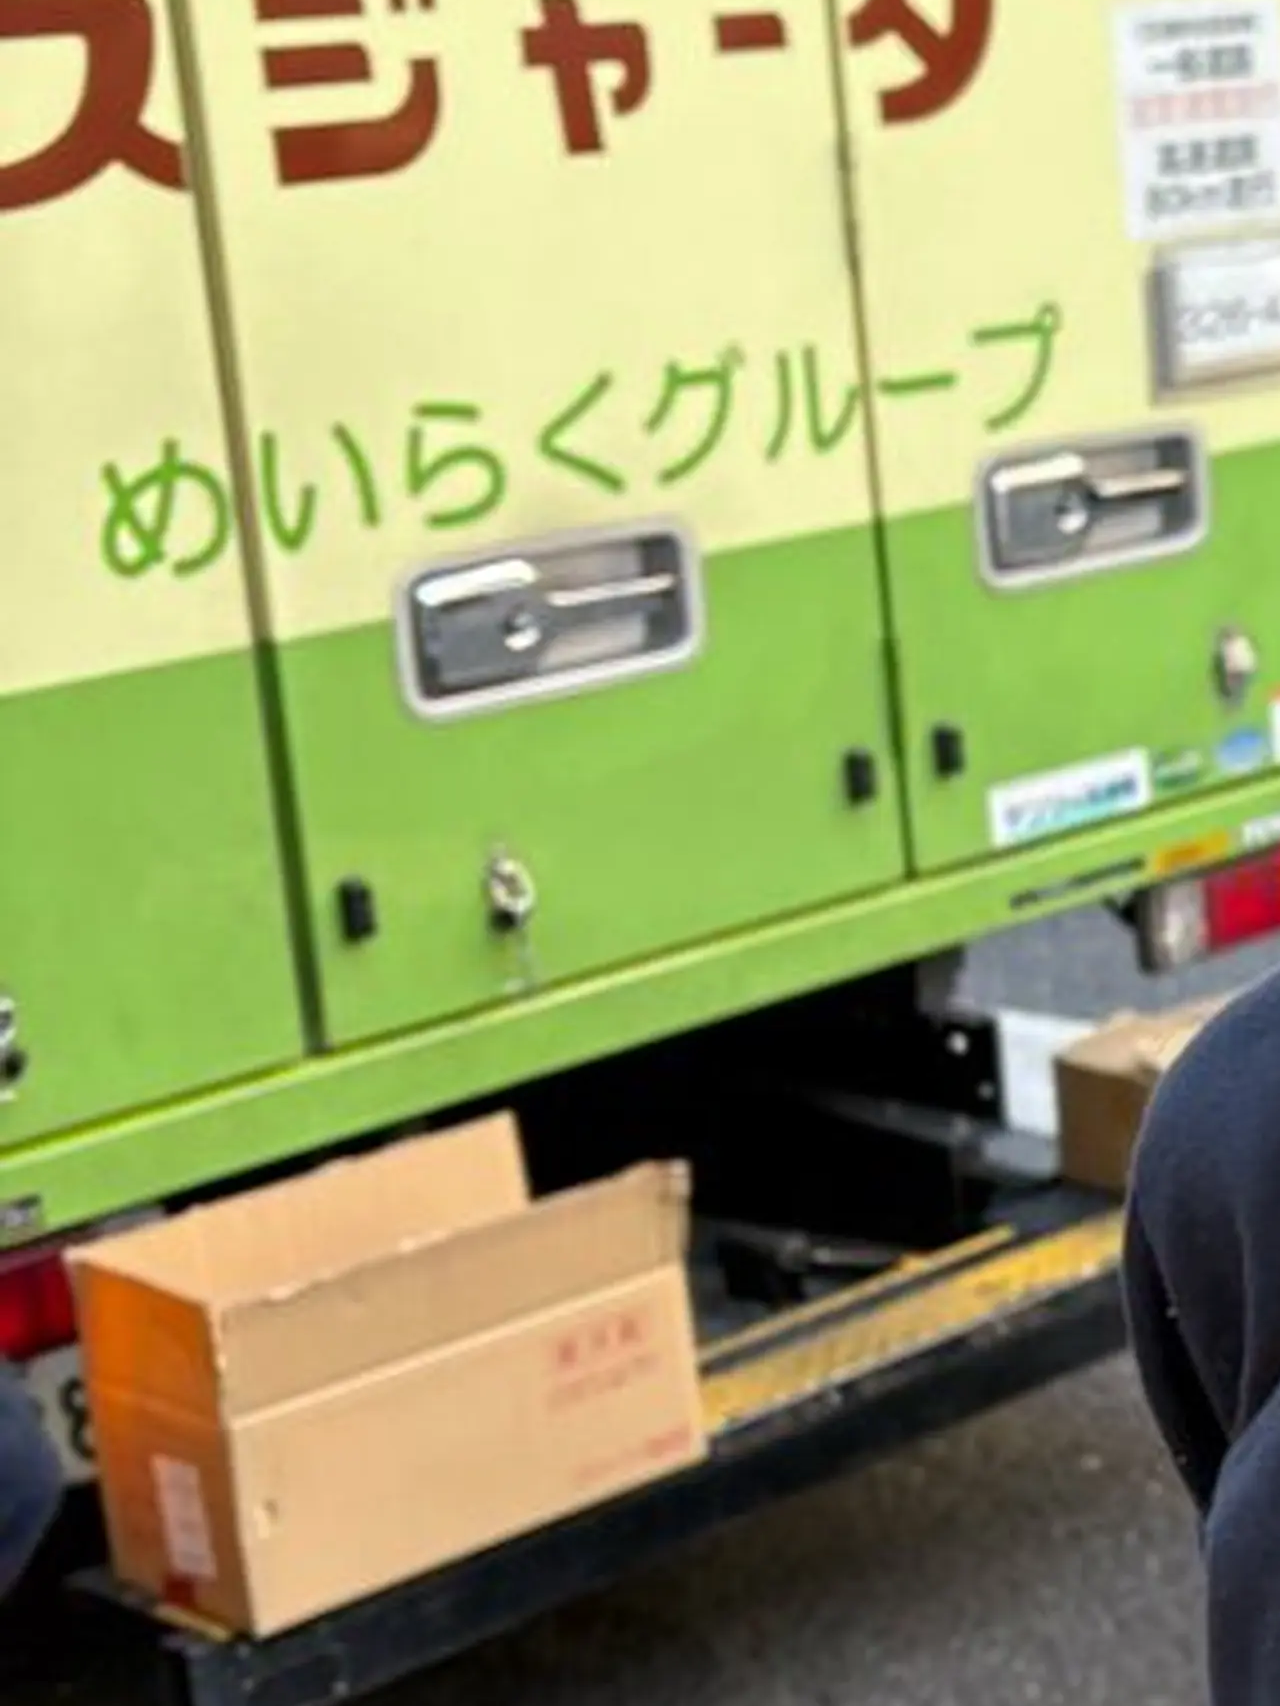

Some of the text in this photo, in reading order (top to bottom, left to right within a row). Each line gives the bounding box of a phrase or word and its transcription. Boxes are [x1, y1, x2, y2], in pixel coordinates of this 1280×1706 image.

[100, 301, 1064, 579] めいらくグループ
